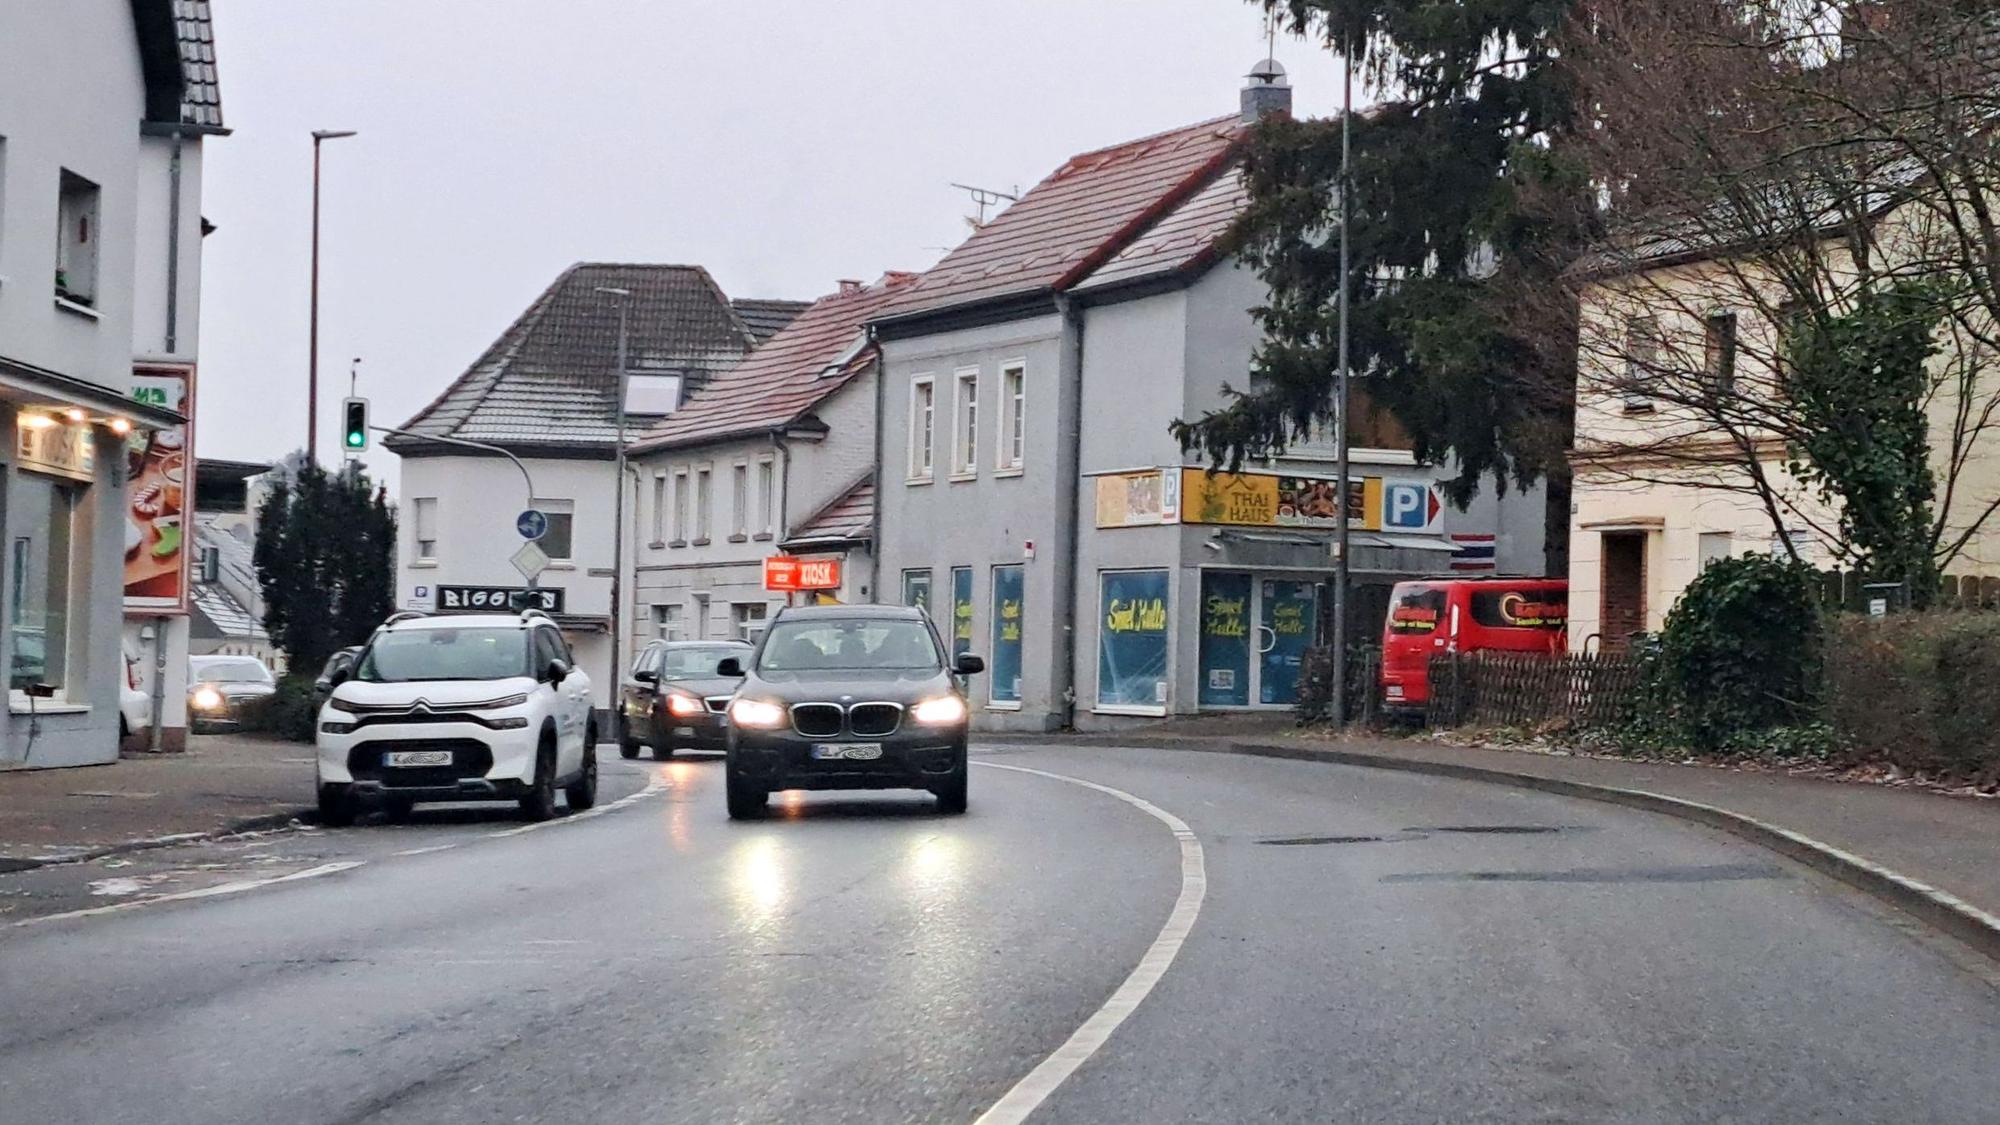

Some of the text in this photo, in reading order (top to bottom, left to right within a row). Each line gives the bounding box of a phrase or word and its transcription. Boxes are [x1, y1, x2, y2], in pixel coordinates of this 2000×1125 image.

[1231, 492, 1269, 507] THAI
[1392, 486, 1419, 524] P
[1230, 507, 1271, 522] HAUS
[801, 562, 833, 586] KIOSK
[444, 589, 556, 609] BIGGN
